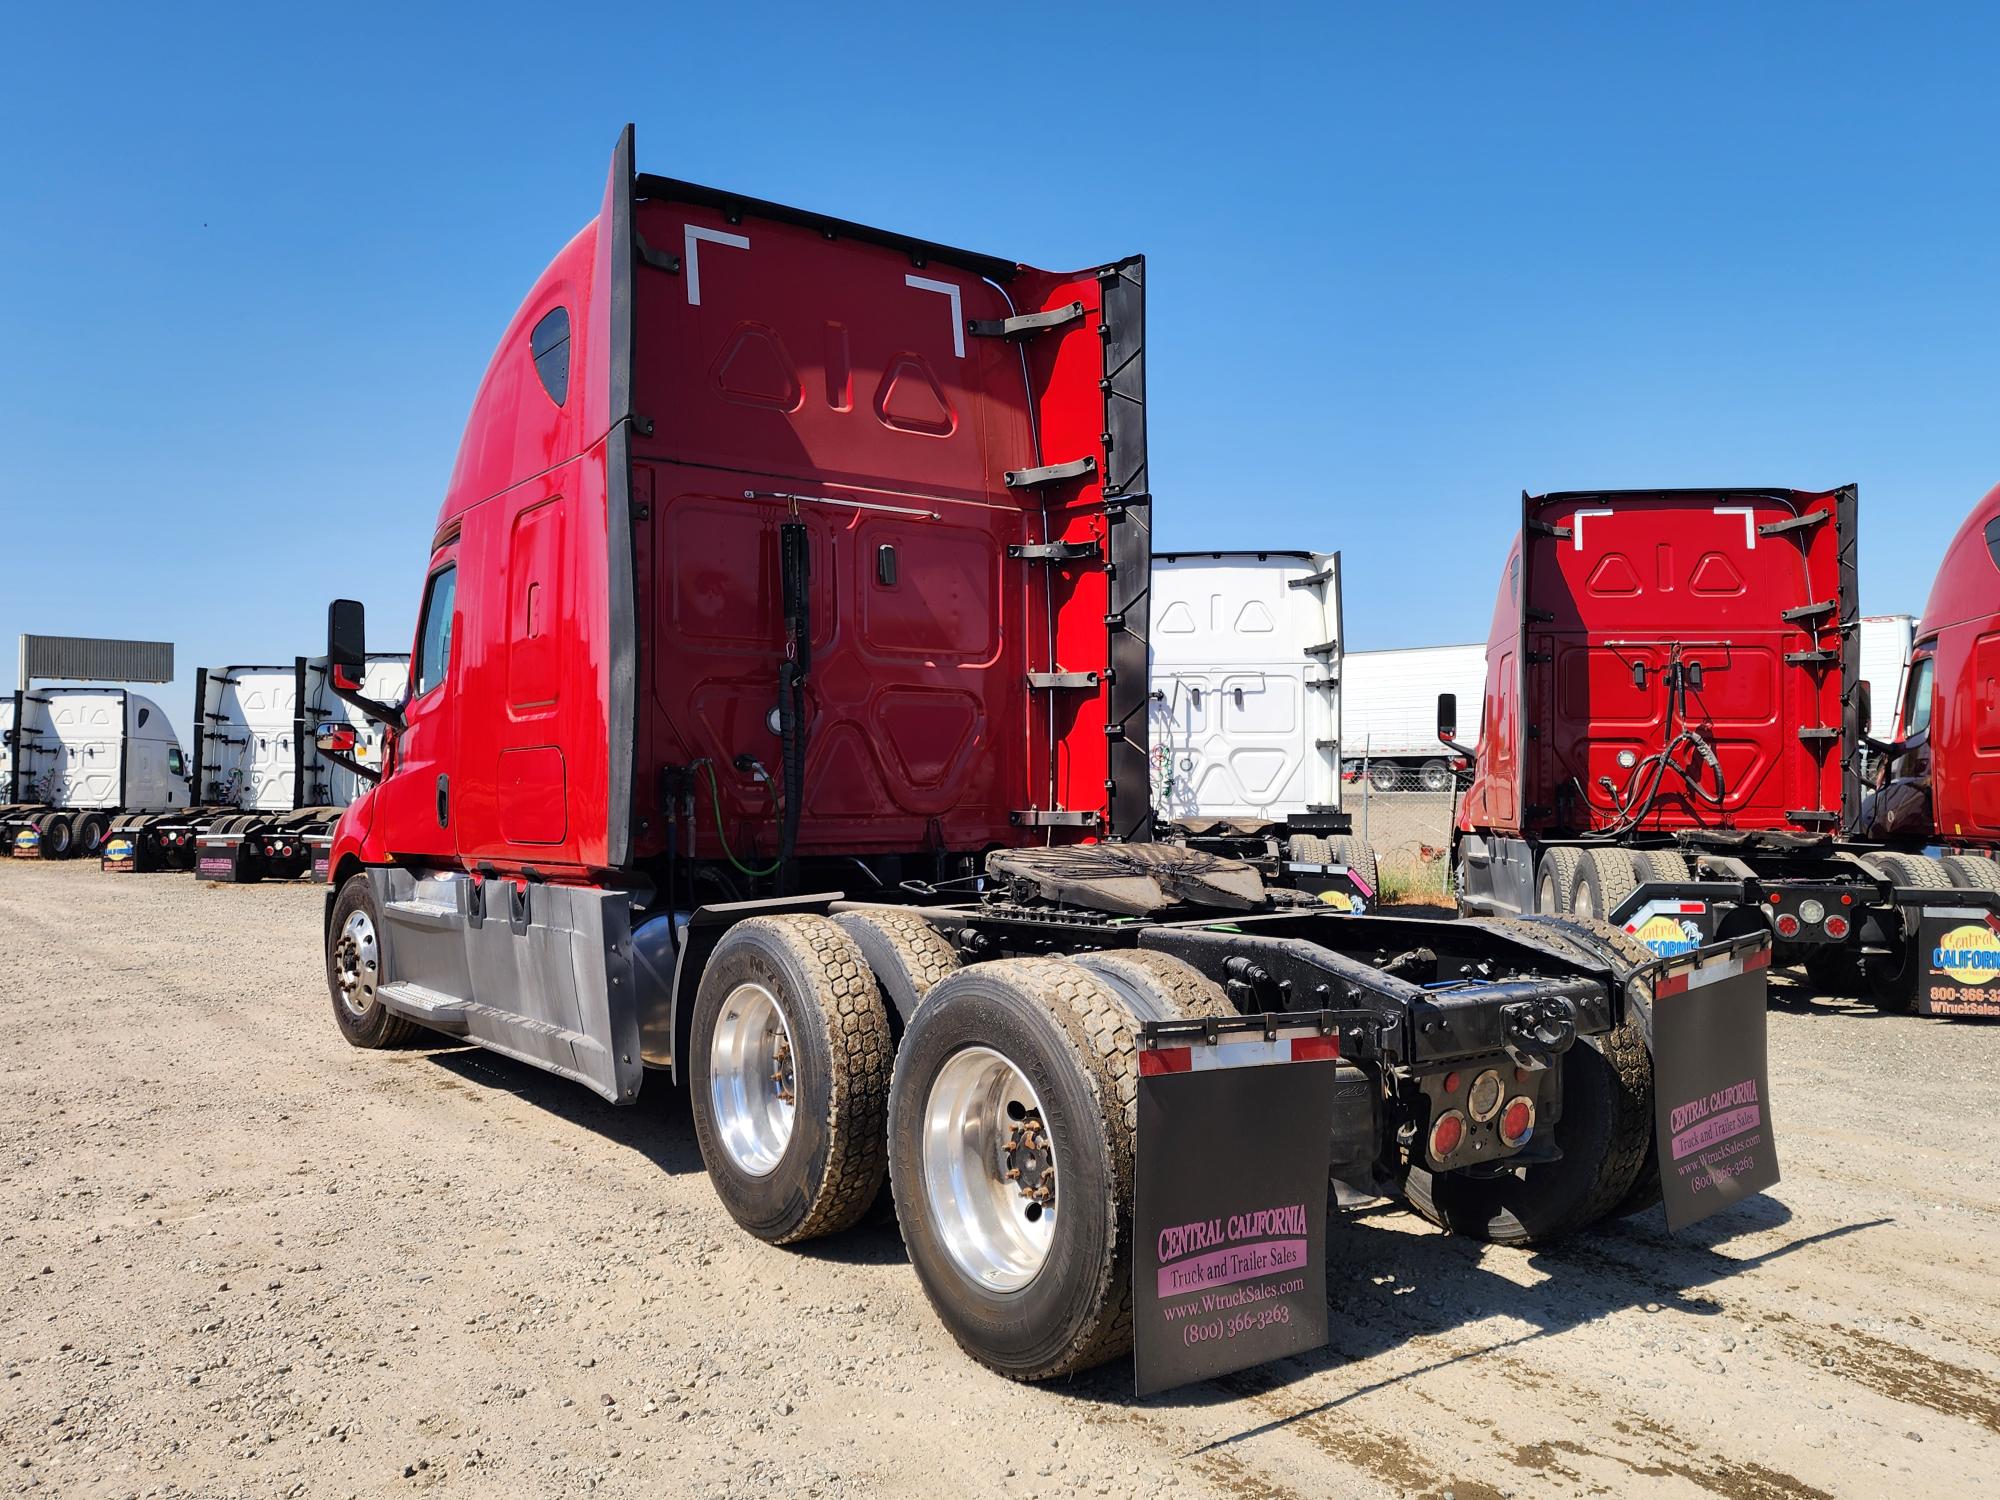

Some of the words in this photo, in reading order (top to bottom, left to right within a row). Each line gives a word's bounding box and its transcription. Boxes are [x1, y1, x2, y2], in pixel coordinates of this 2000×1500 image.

[1640, 918, 1679, 940] entral
[1941, 927, 1995, 949] Central
[1670, 1097, 1710, 1134] CENTRAL
[1710, 1079, 1758, 1112] CALIFORNIA
[1680, 1131, 1699, 1152] Truck
[1701, 1126, 1713, 1142] and
[1714, 1117, 1736, 1137] Trailer
[1737, 1113, 1753, 1128] Sales
[1691, 1171, 1716, 1194] (800)
[1716, 1156, 1754, 1184] 366-3263
[1158, 1219, 1225, 1263] CENTRAL
[1227, 1204, 1307, 1241] CALIFORNIA
[1171, 1264, 1204, 1289] Truck
[1207, 1257, 1228, 1280] and
[1231, 1251, 1267, 1275] Trailer
[1270, 1247, 1297, 1267] Sales
[1164, 1278, 1305, 1321] www.WtruckSales.com
[1183, 1318, 1224, 1347] (800)
[1227, 1304, 1290, 1338] 366-3263
